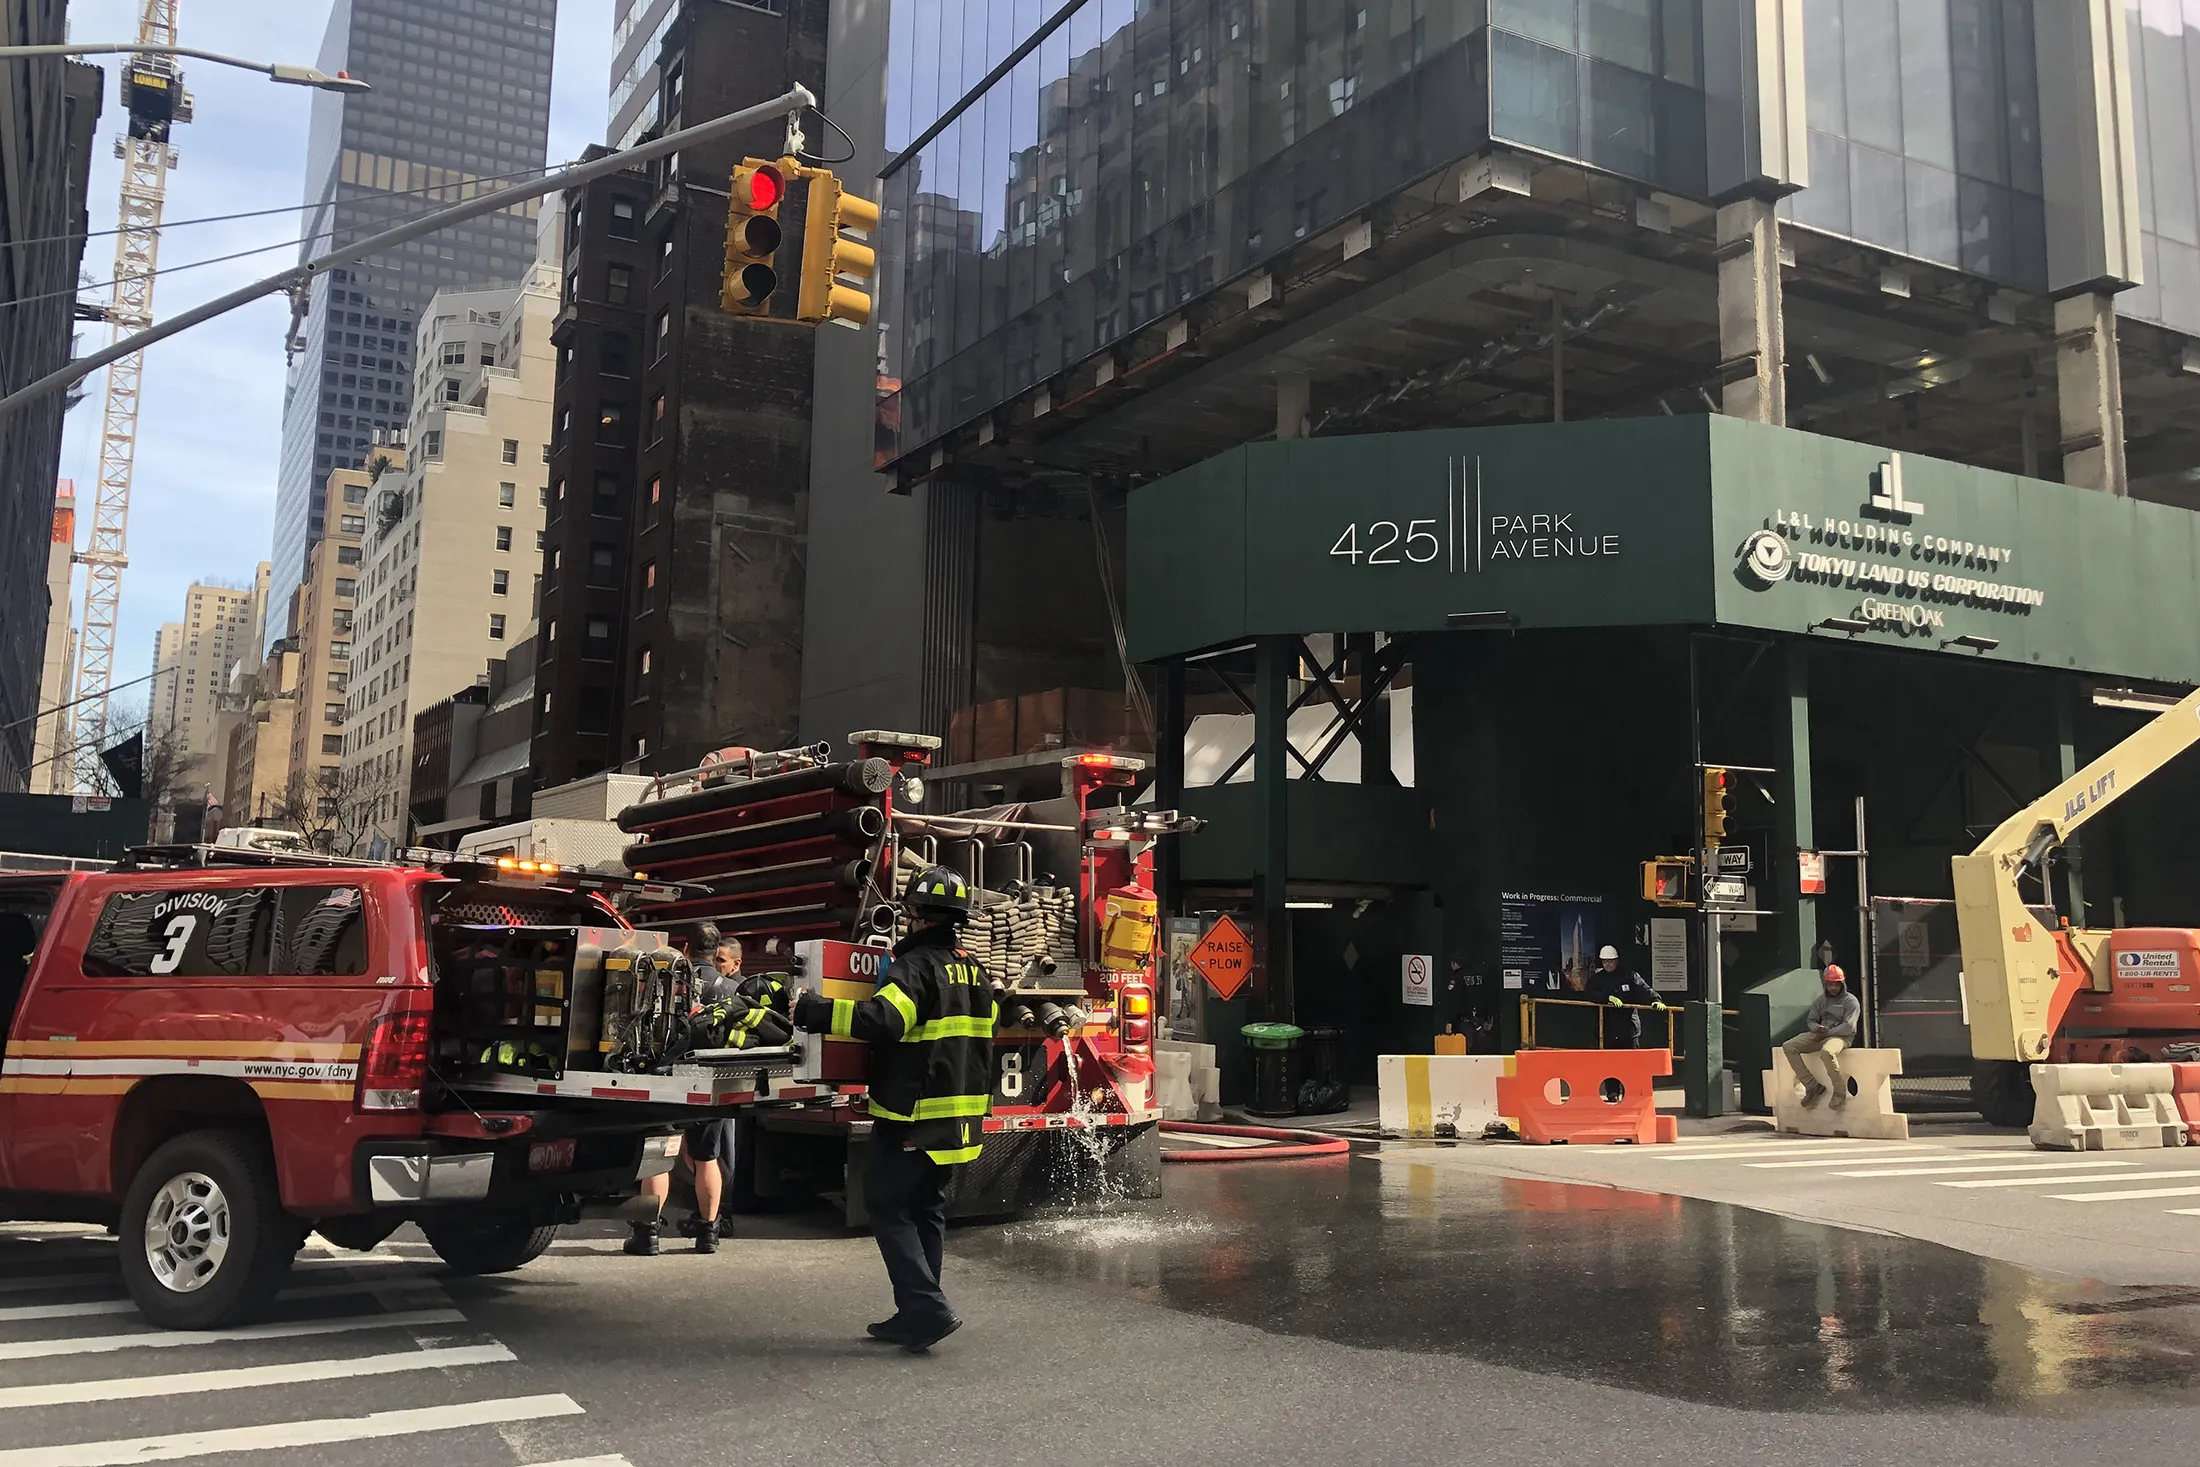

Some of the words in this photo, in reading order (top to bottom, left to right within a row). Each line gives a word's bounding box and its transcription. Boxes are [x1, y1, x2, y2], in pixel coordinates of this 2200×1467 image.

[1492, 513, 1573, 535] PARK
[1330, 519, 1439, 564] 425
[1776, 508, 1813, 530] L&L
[1825, 517, 1913, 546] HOLDING
[1924, 535, 2012, 563] COMPANY
[1491, 535, 1620, 559] AVENUE
[1797, 552, 1856, 577] TOKYU
[1859, 562, 1903, 584] LAND
[1907, 571, 1930, 589] US
[1932, 575, 2044, 606] CORPORATION
[2064, 791, 2086, 823] JLG
[2089, 769, 2116, 804] LIFT
[1724, 854, 1743, 865] WAY
[1502, 892, 1520, 900] Work
[1530, 893, 1559, 902] Progress:
[1561, 894, 1602, 903] Commercial
[1707, 882, 1721, 894] ONE
[1728, 884, 1744, 895] WAY
[155, 893, 227, 919] DIVISION
[150, 914, 197, 974] 3
[1208, 942, 1243, 953] RAISE
[1209, 958, 1242, 969] PLOW
[2142, 959, 2175, 967] Rentals
[1100, 973, 1119, 983] 200
[1121, 973, 1144, 983] FEET
[244, 1064, 353, 1079] www.nyc.gov/fdny
[1001, 1053, 1022, 1098] 8
